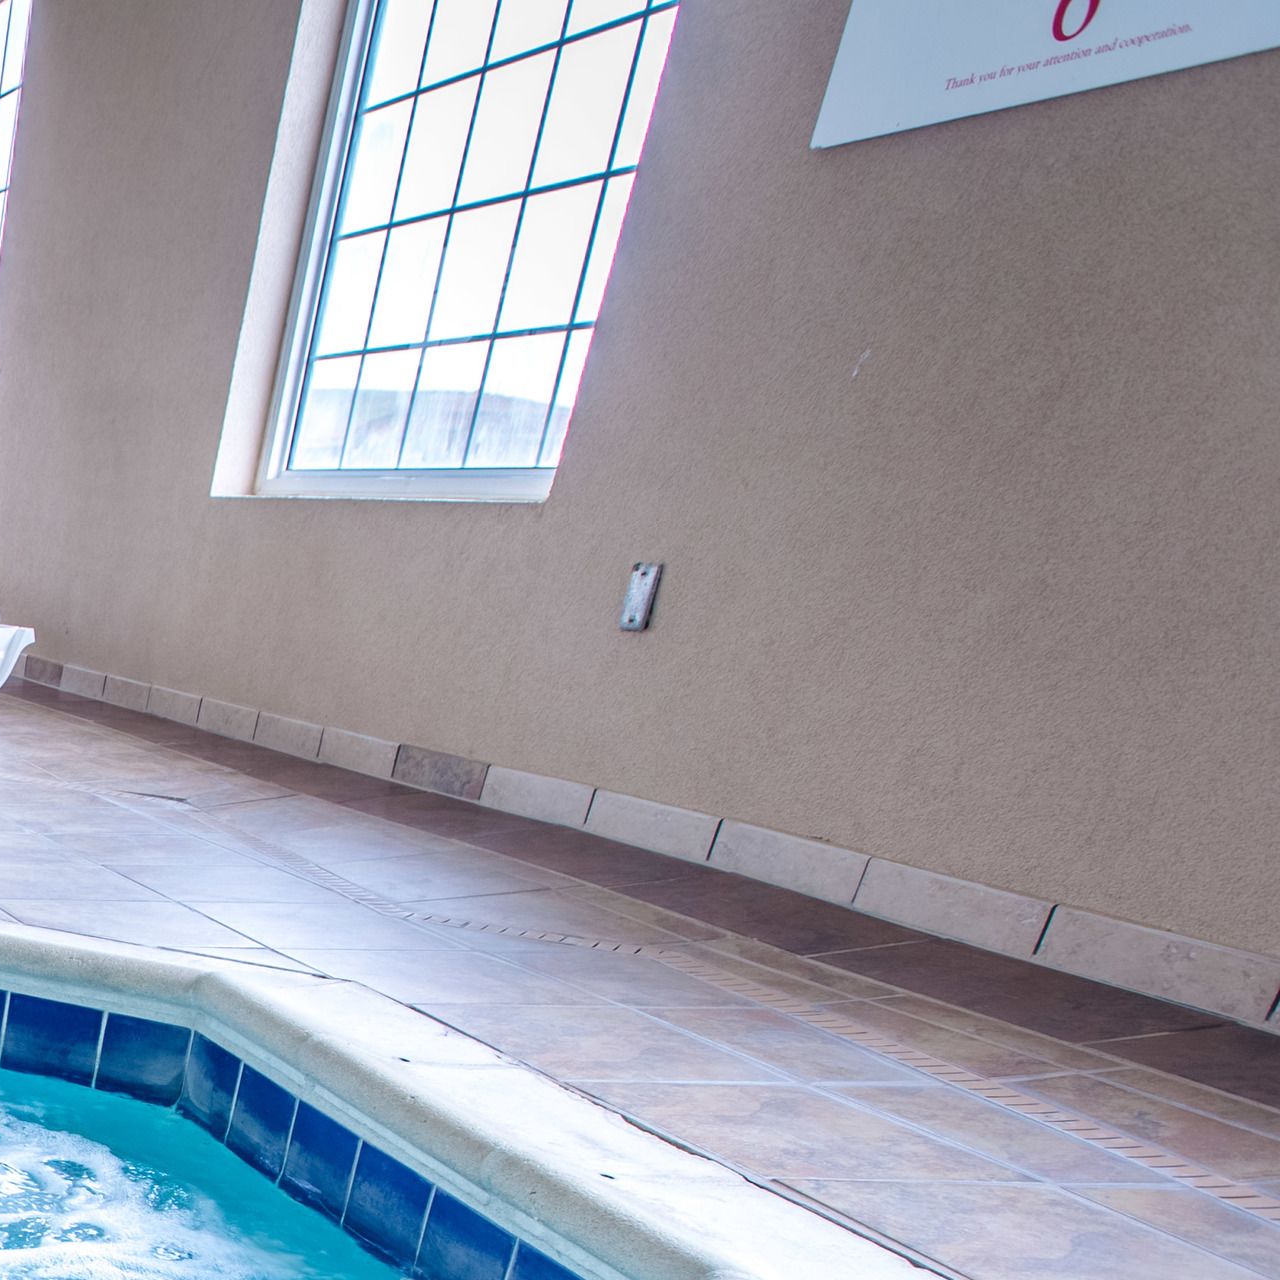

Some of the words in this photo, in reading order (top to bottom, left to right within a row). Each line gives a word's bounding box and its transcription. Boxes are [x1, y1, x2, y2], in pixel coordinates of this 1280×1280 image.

[945, 72, 975, 91] Thank
[977, 71, 997, 86] you
[998, 64, 1015, 79] for
[1016, 60, 1040, 76] your
[1042, 48, 1092, 68] attention
[1095, 37, 1119, 55] and
[1119, 24, 1193, 48] cooperation.
